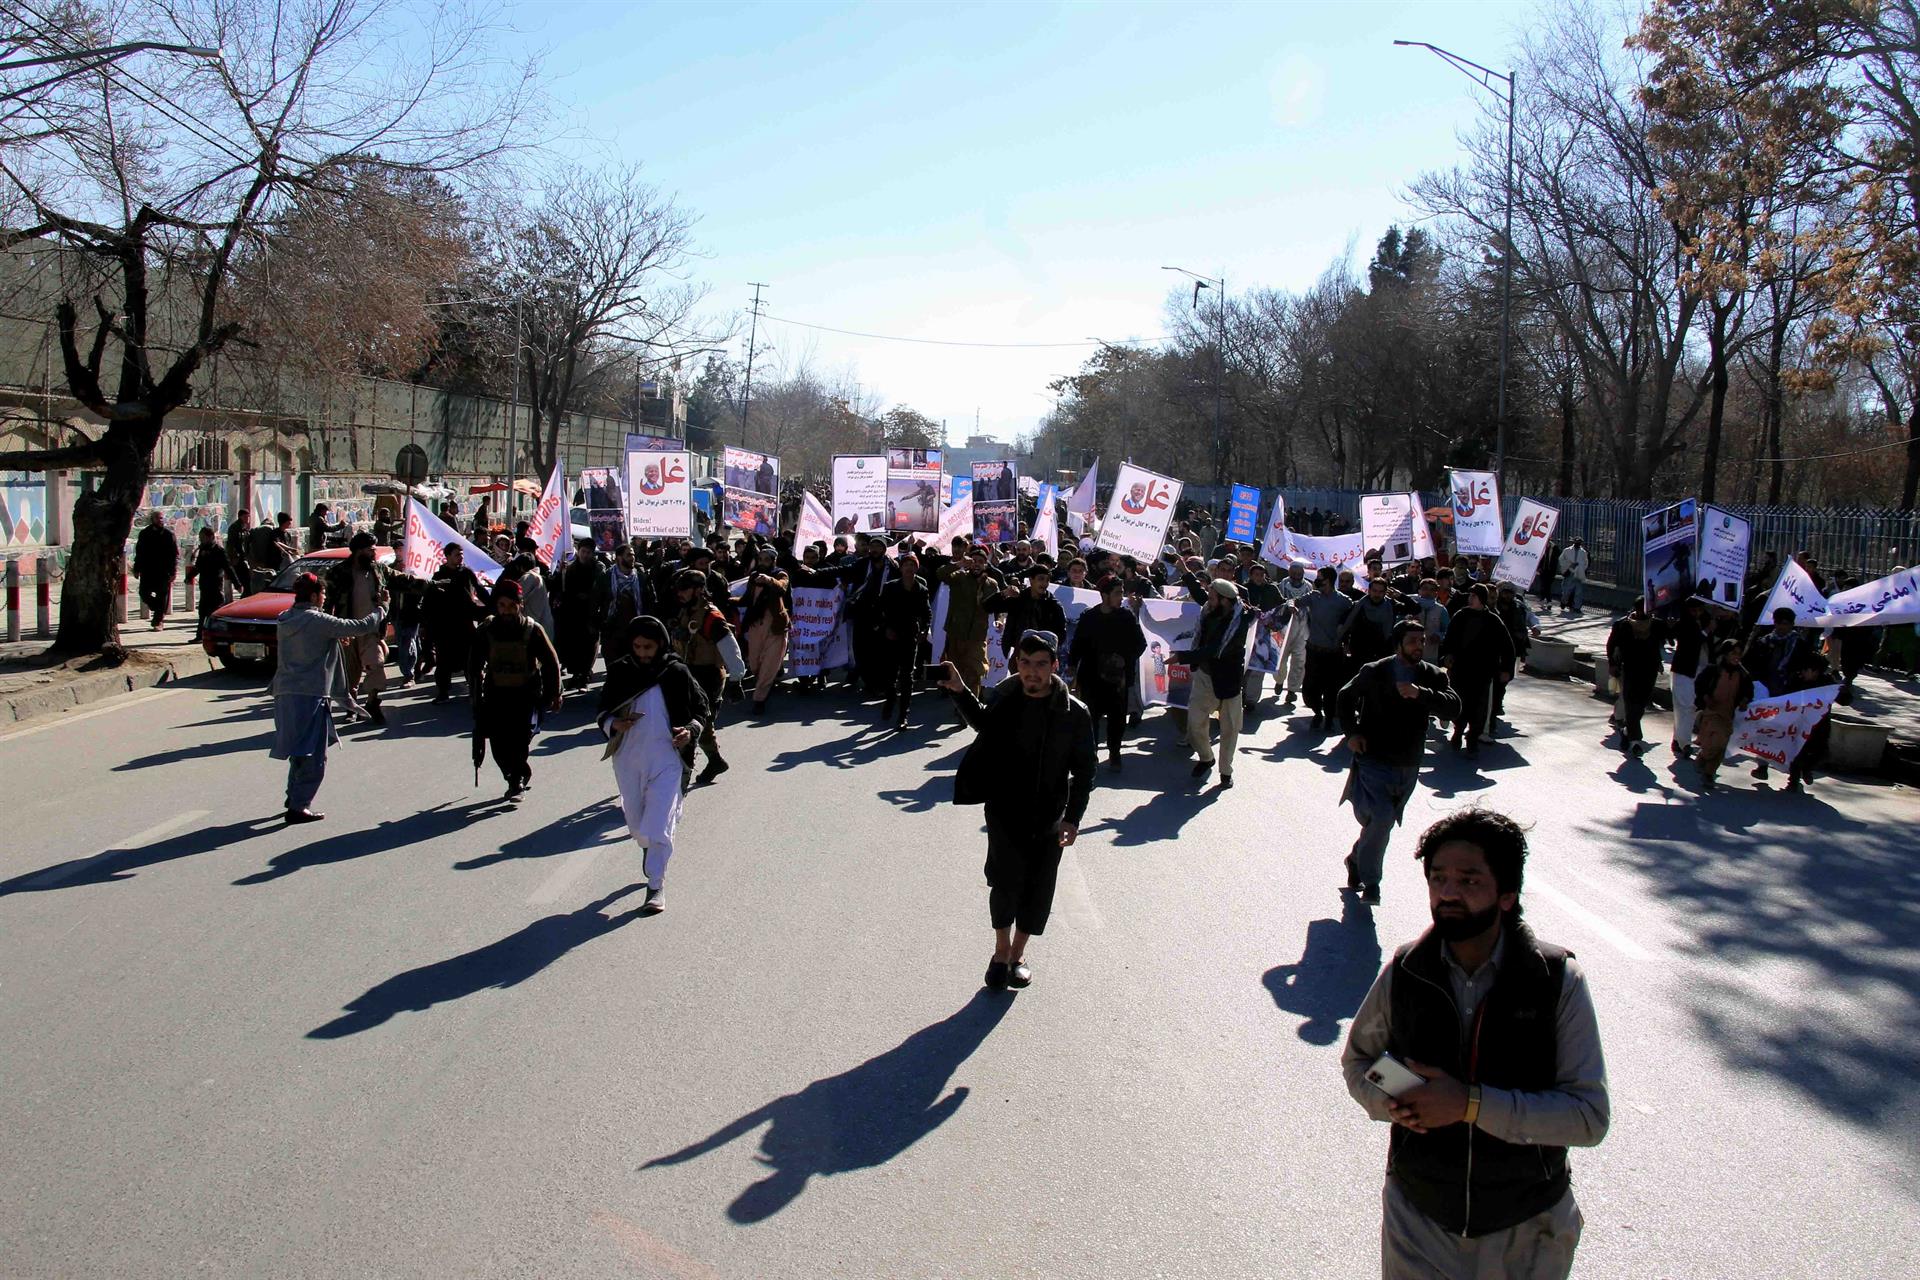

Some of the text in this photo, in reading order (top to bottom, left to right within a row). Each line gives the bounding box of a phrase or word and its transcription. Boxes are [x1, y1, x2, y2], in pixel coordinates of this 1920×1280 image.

[640, 456, 685, 496] غل
[1121, 479, 1169, 515] غل
[1456, 480, 1491, 517] غل
[633, 525, 651, 533] World
[676, 526, 689, 534] 2022
[1102, 530, 1122, 541] Biden!
[1514, 511, 1549, 546] غل
[1101, 538, 1118, 549] World
[1119, 544, 1134, 555] Thief
[1141, 551, 1154, 561] 2022
[1170, 669, 1188, 681] Gift
